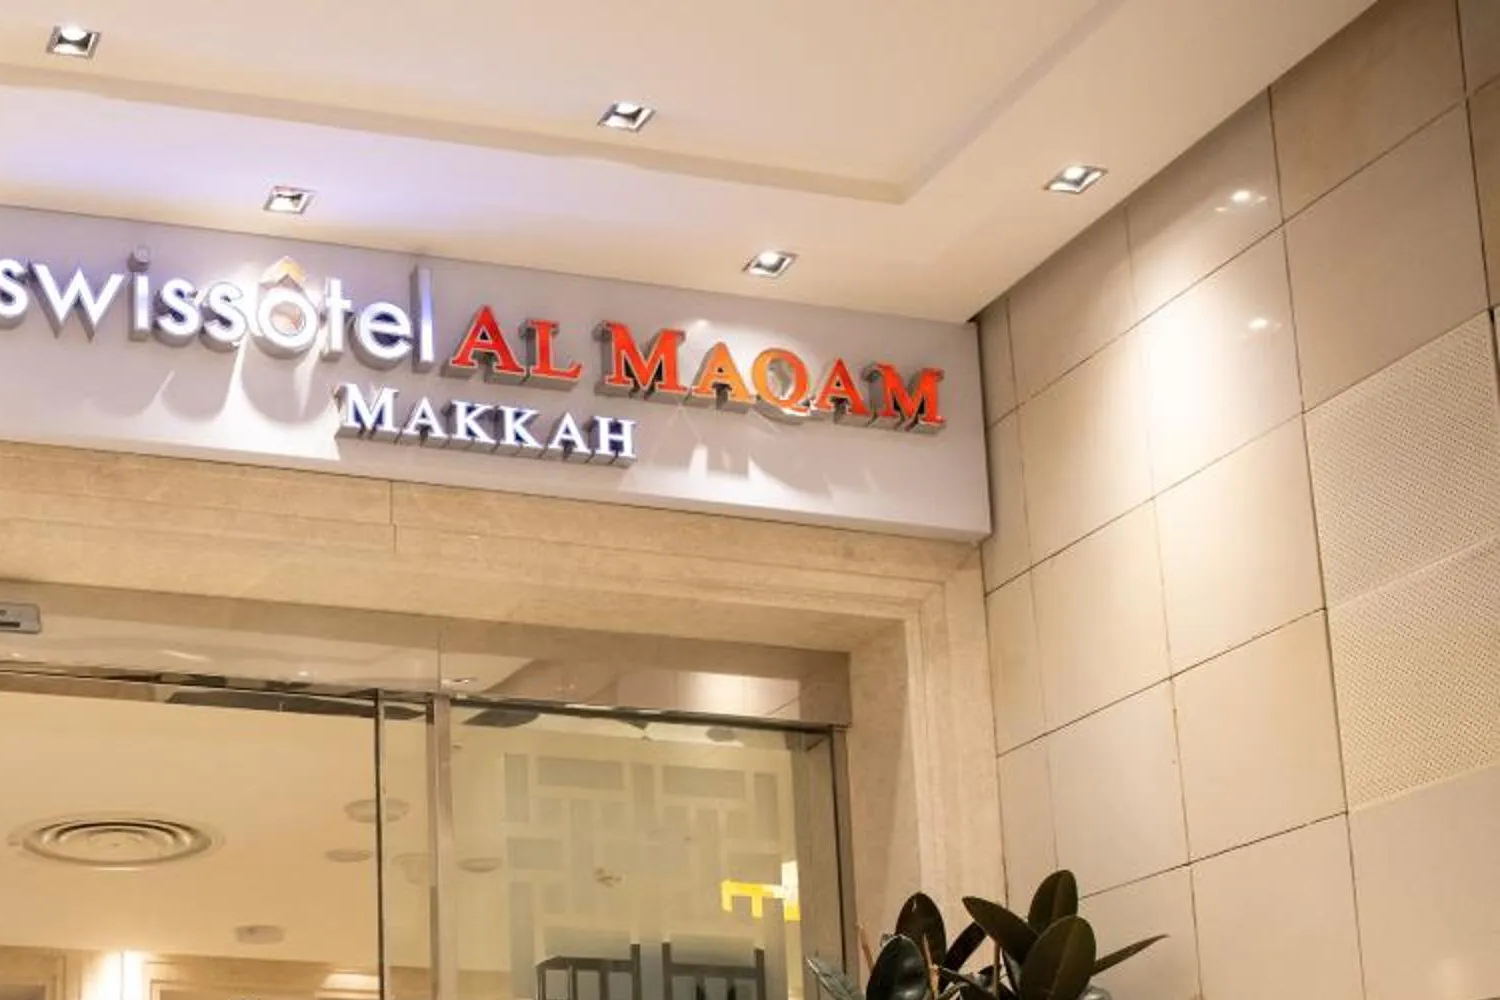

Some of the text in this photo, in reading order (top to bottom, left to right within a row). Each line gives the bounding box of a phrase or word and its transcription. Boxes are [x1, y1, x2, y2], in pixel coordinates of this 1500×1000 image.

[450, 304, 582, 380] AL
[603, 320, 947, 426] MAQAM
[342, 381, 637, 461] MAKKAH
